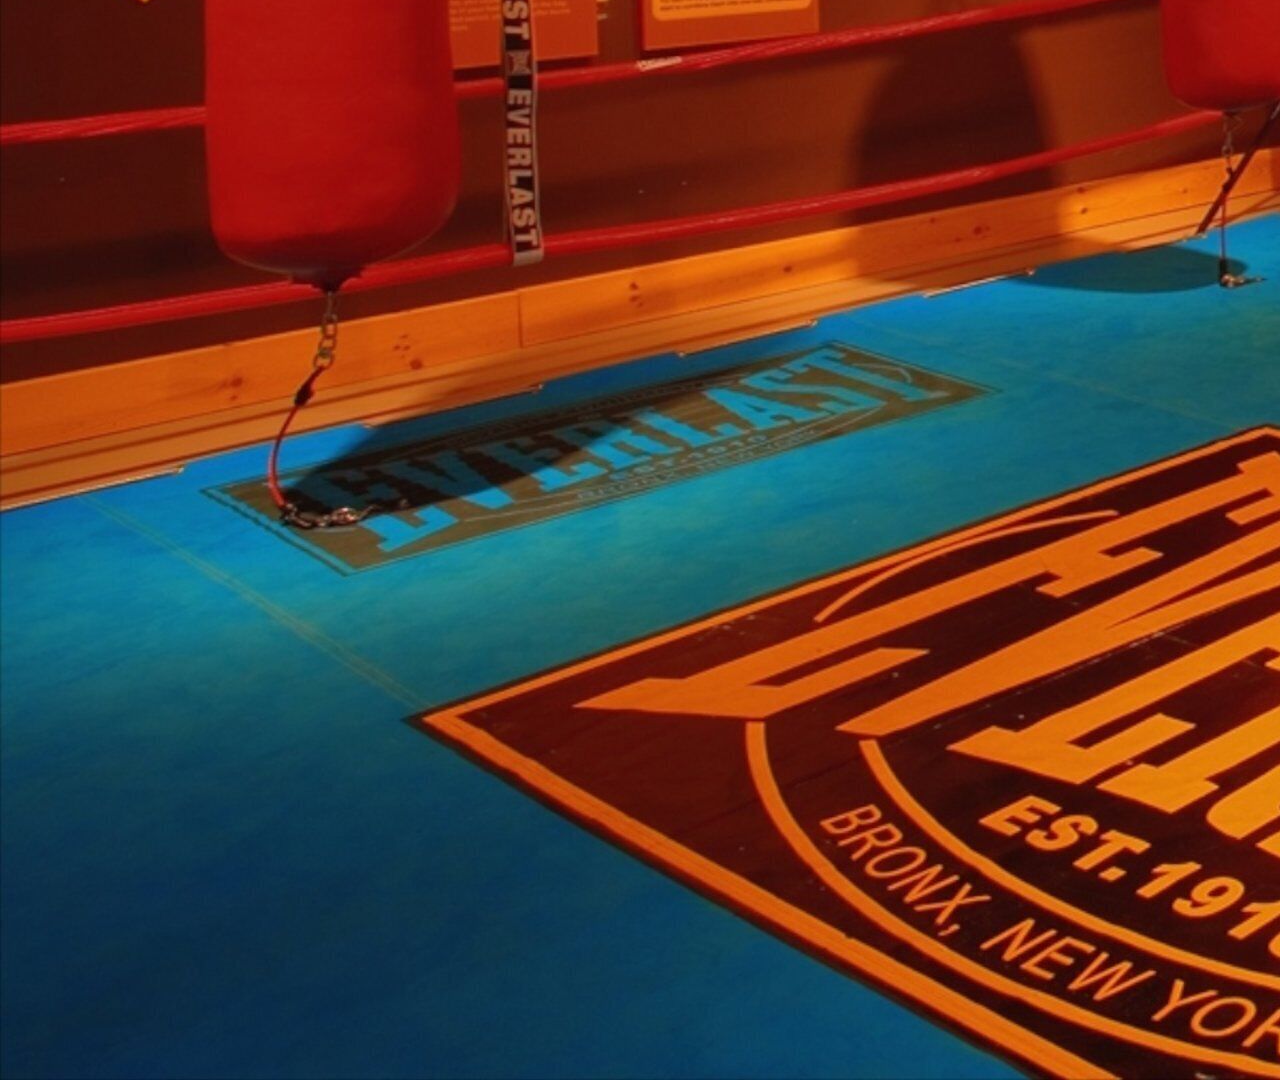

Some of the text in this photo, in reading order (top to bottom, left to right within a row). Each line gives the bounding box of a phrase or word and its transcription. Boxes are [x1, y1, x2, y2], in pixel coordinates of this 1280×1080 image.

[506, 89, 540, 249] EVERLAST
[303, 352, 951, 552] EVERLAST
[818, 803, 992, 938] BRONX,
[980, 916, 1134, 1005] NEW
